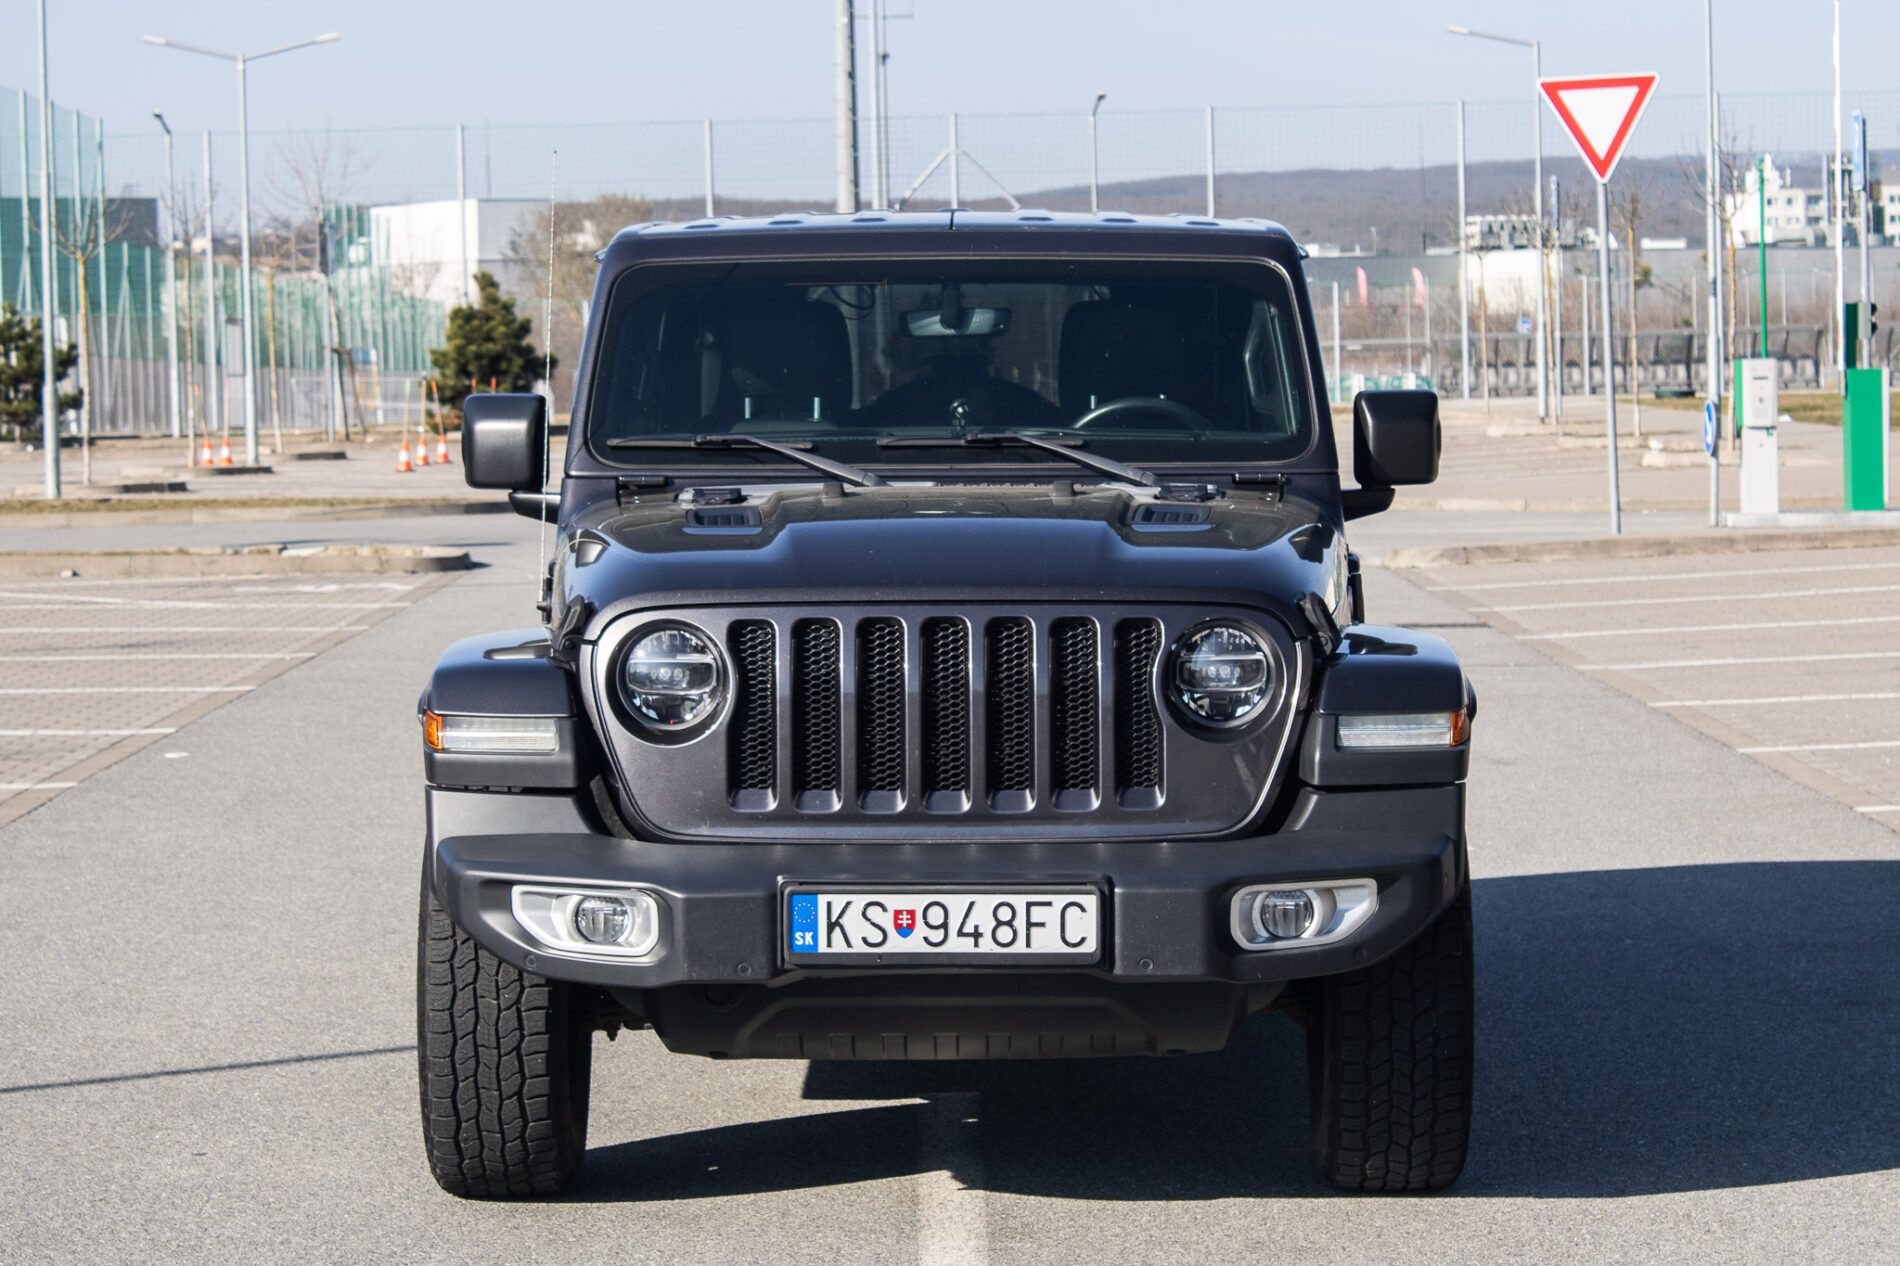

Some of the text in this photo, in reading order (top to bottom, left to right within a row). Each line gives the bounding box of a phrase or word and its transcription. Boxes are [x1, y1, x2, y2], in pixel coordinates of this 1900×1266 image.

[794, 931, 814, 946] SK
[826, 900, 1087, 948] KS 948FC
